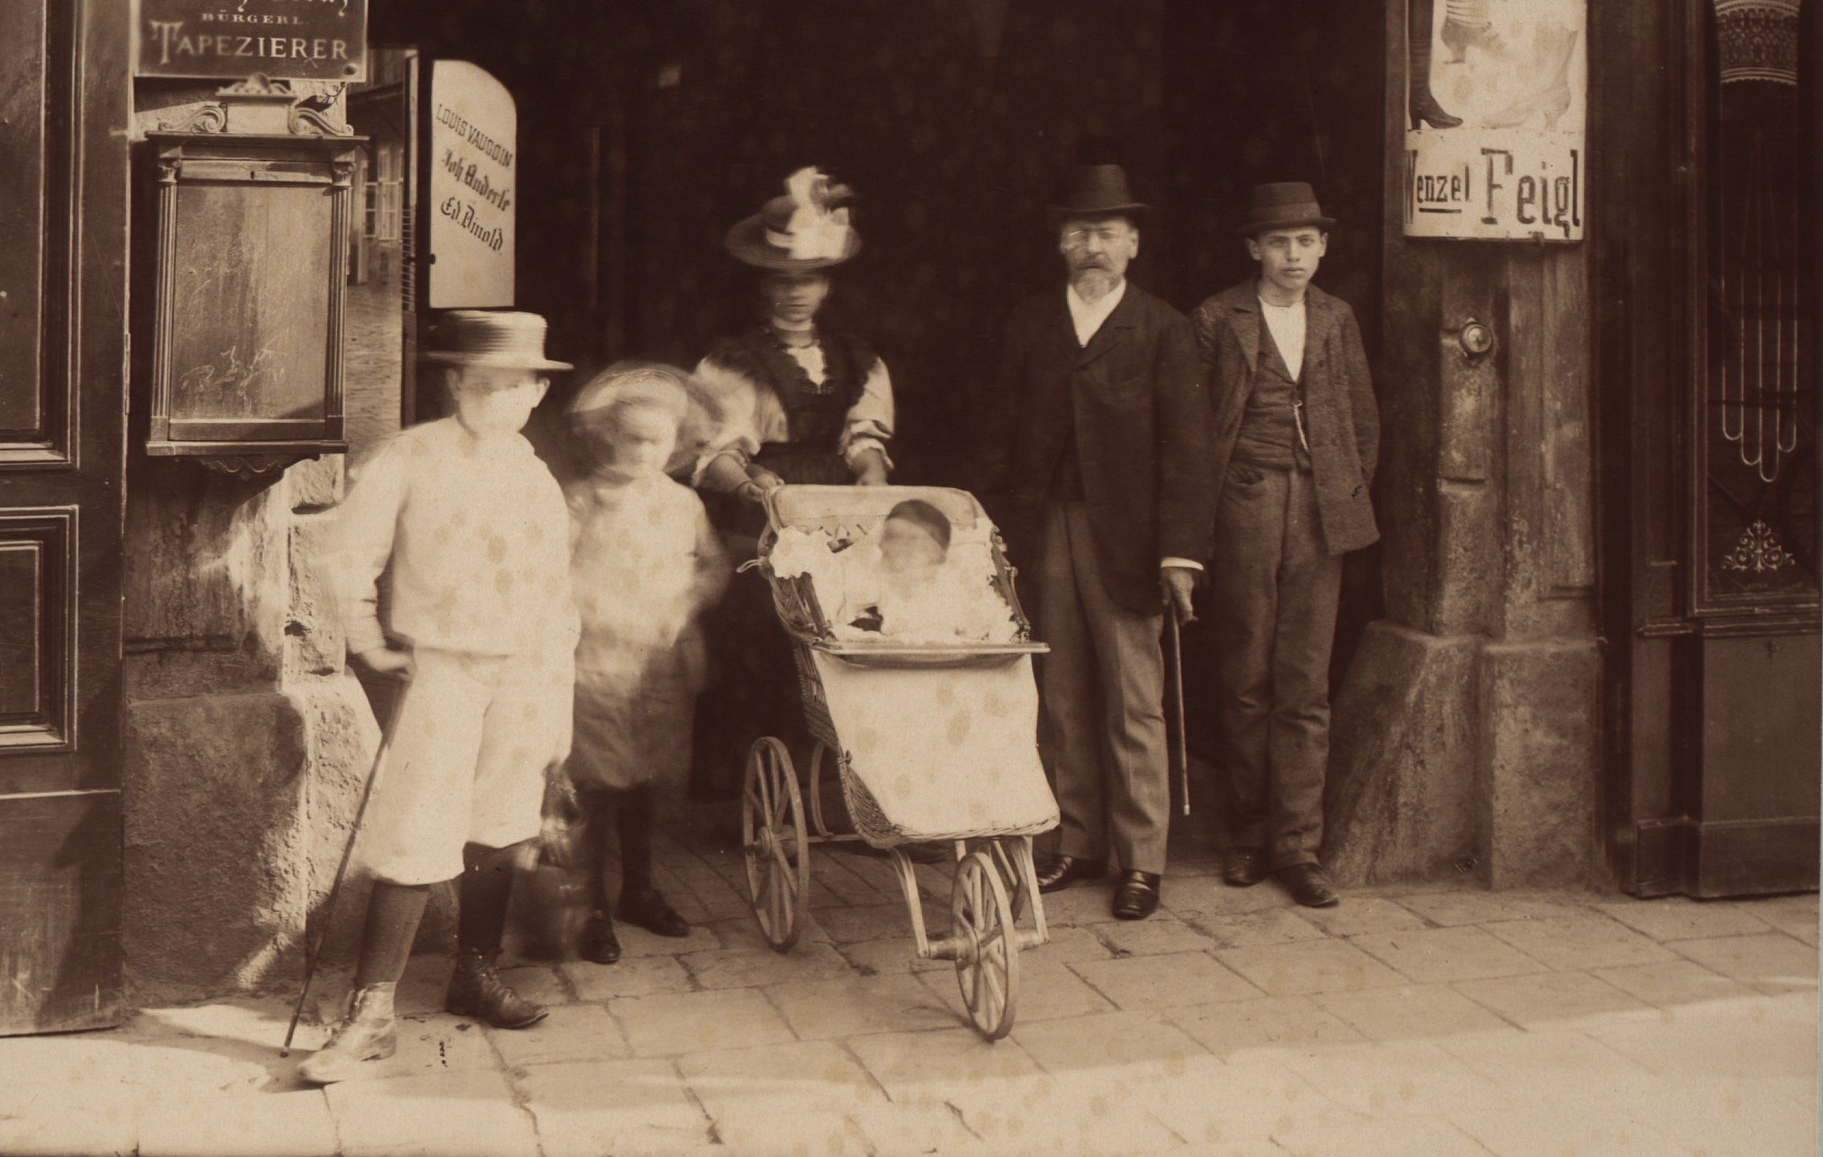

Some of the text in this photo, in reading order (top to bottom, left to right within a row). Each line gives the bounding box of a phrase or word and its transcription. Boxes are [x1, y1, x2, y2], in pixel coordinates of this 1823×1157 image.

[148, 20, 348, 66] TAPEZIERER
[435, 103, 468, 137] LOUIS
[440, 196, 462, 224] Ed.
[1479, 146, 1581, 238] Feigl
